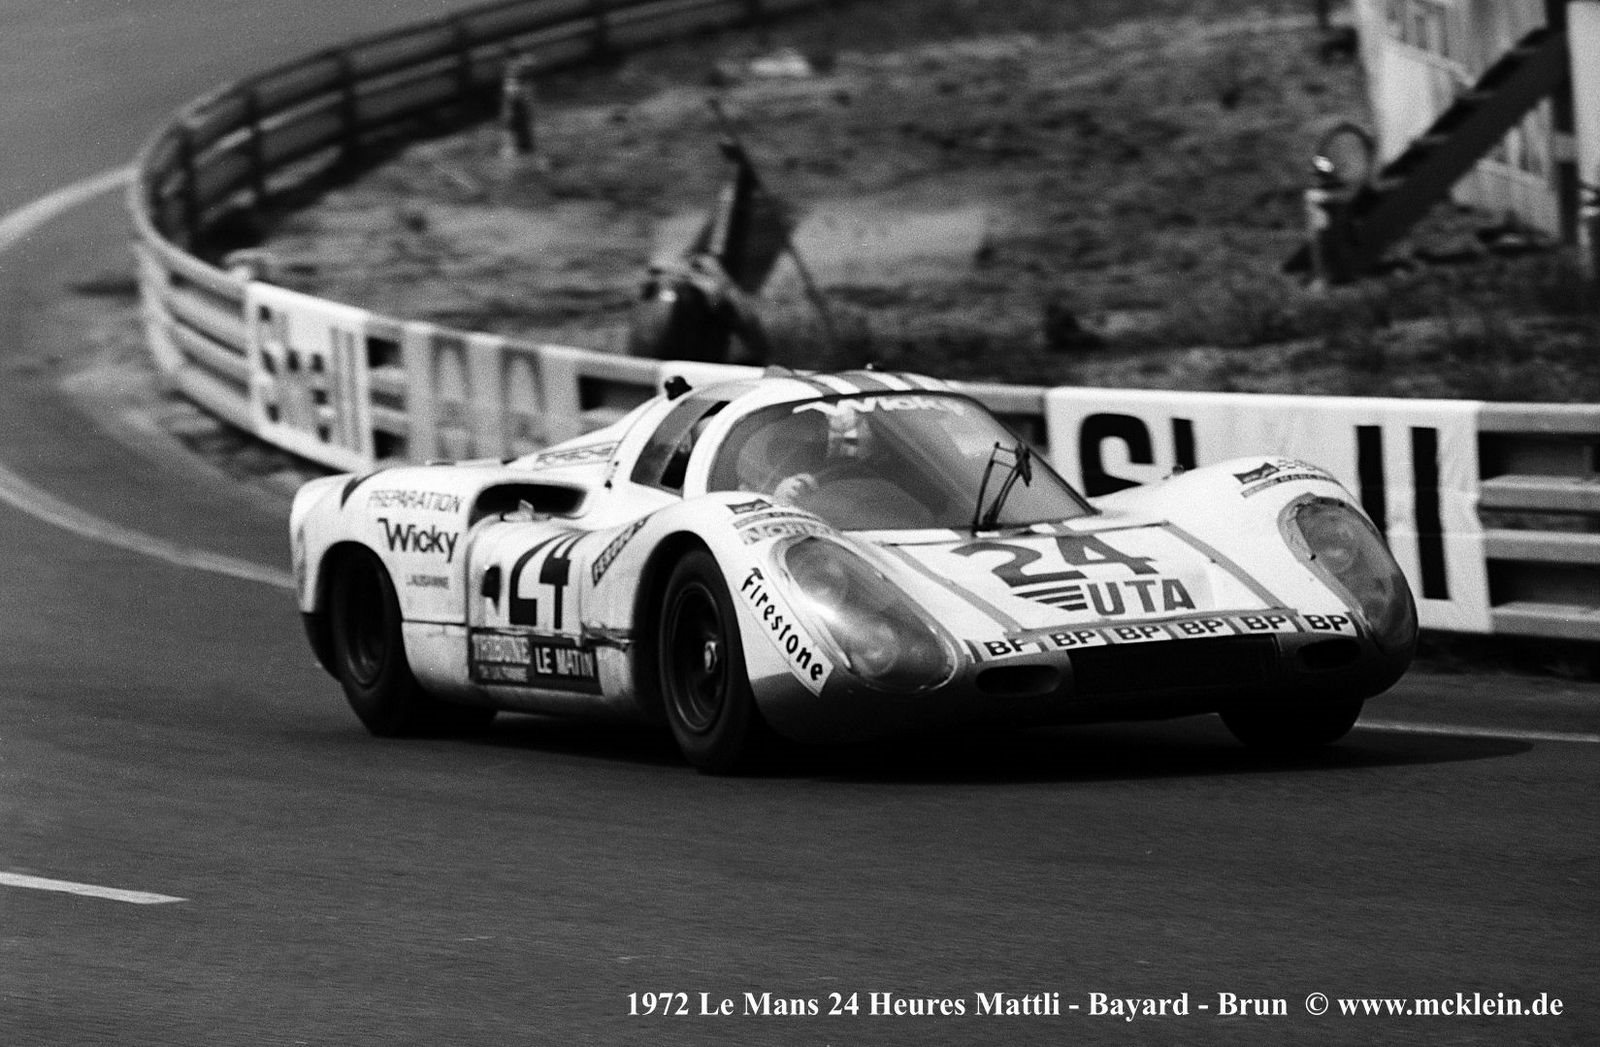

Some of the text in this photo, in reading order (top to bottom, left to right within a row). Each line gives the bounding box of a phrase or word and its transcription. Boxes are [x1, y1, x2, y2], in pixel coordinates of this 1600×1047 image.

[377, 517, 459, 563] Wicky
[950, 535, 1160, 588] 24
[1087, 579, 1196, 616] UTA
[741, 566, 824, 681] Firestone
[1050, 630, 1096, 647] BP
[1114, 624, 1160, 641] BP
[1177, 619, 1224, 635] BP
[1239, 615, 1287, 631] BP
[1304, 613, 1349, 632] BP
[535, 647, 553, 674] LE
[555, 648, 594, 677] MATIN
